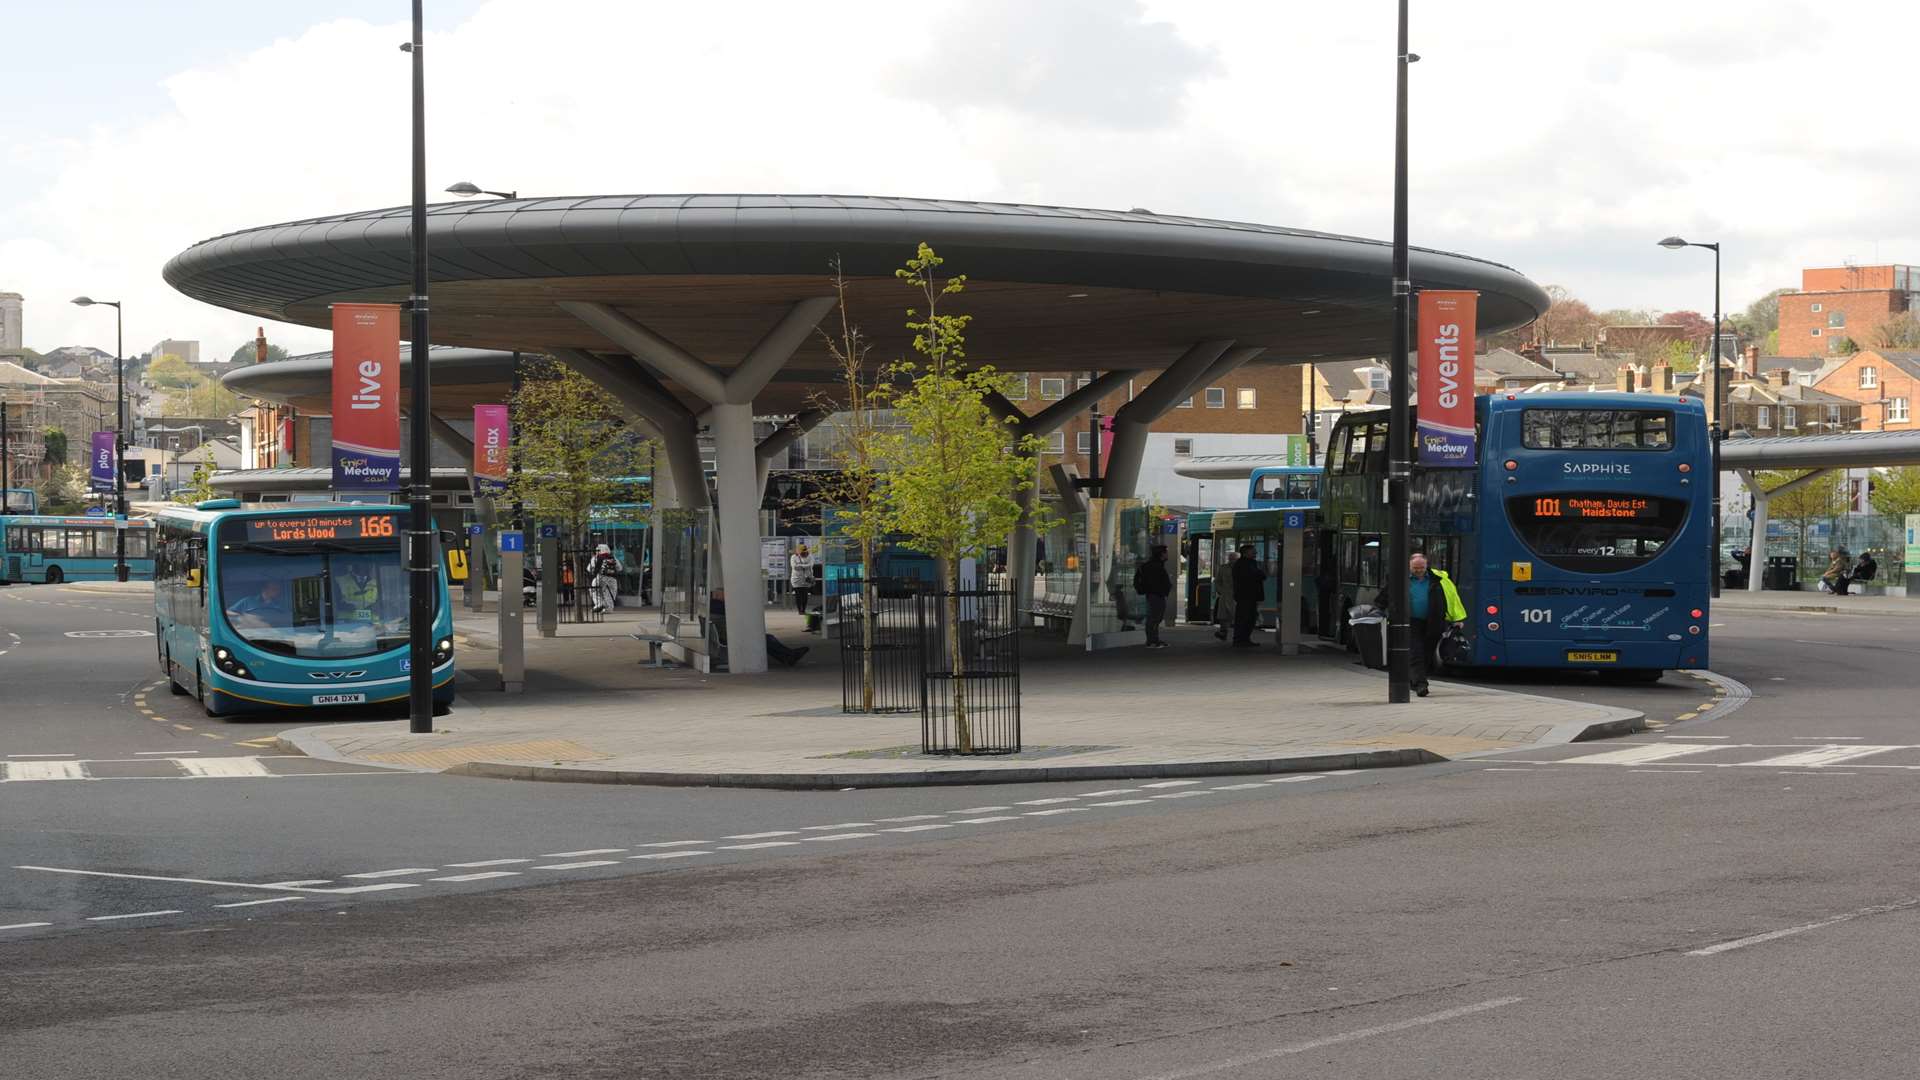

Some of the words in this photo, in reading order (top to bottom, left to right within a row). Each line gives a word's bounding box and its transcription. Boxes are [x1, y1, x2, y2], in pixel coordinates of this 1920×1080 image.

[1434, 324, 1459, 409] events
[351, 360, 382, 410] live
[484, 428, 499, 463] relax
[1427, 444, 1468, 455] Medway
[98, 449, 110, 469] play
[344, 466, 392, 478] Medway
[1563, 461, 1632, 475] SAPPHIRE
[1535, 498, 1561, 516] 101
[1608, 499, 1630, 508] Davis
[1582, 508, 1636, 517] Maidstone
[267, 519, 277, 528] to
[307, 518, 318, 527] 10
[319, 516, 353, 527] minutes
[360, 515, 393, 537] 166
[1288, 515, 1299, 527] 8
[273, 529, 305, 540] Lords
[308, 527, 336, 539] Wood
[473, 526, 480, 534] 3
[546, 528, 553, 536] 2
[1168, 524, 1174, 533] 7
[508, 537, 516, 549] 1
[1577, 547, 1599, 556] every
[1600, 546, 1615, 556] 12
[1520, 609, 1552, 623] 101
